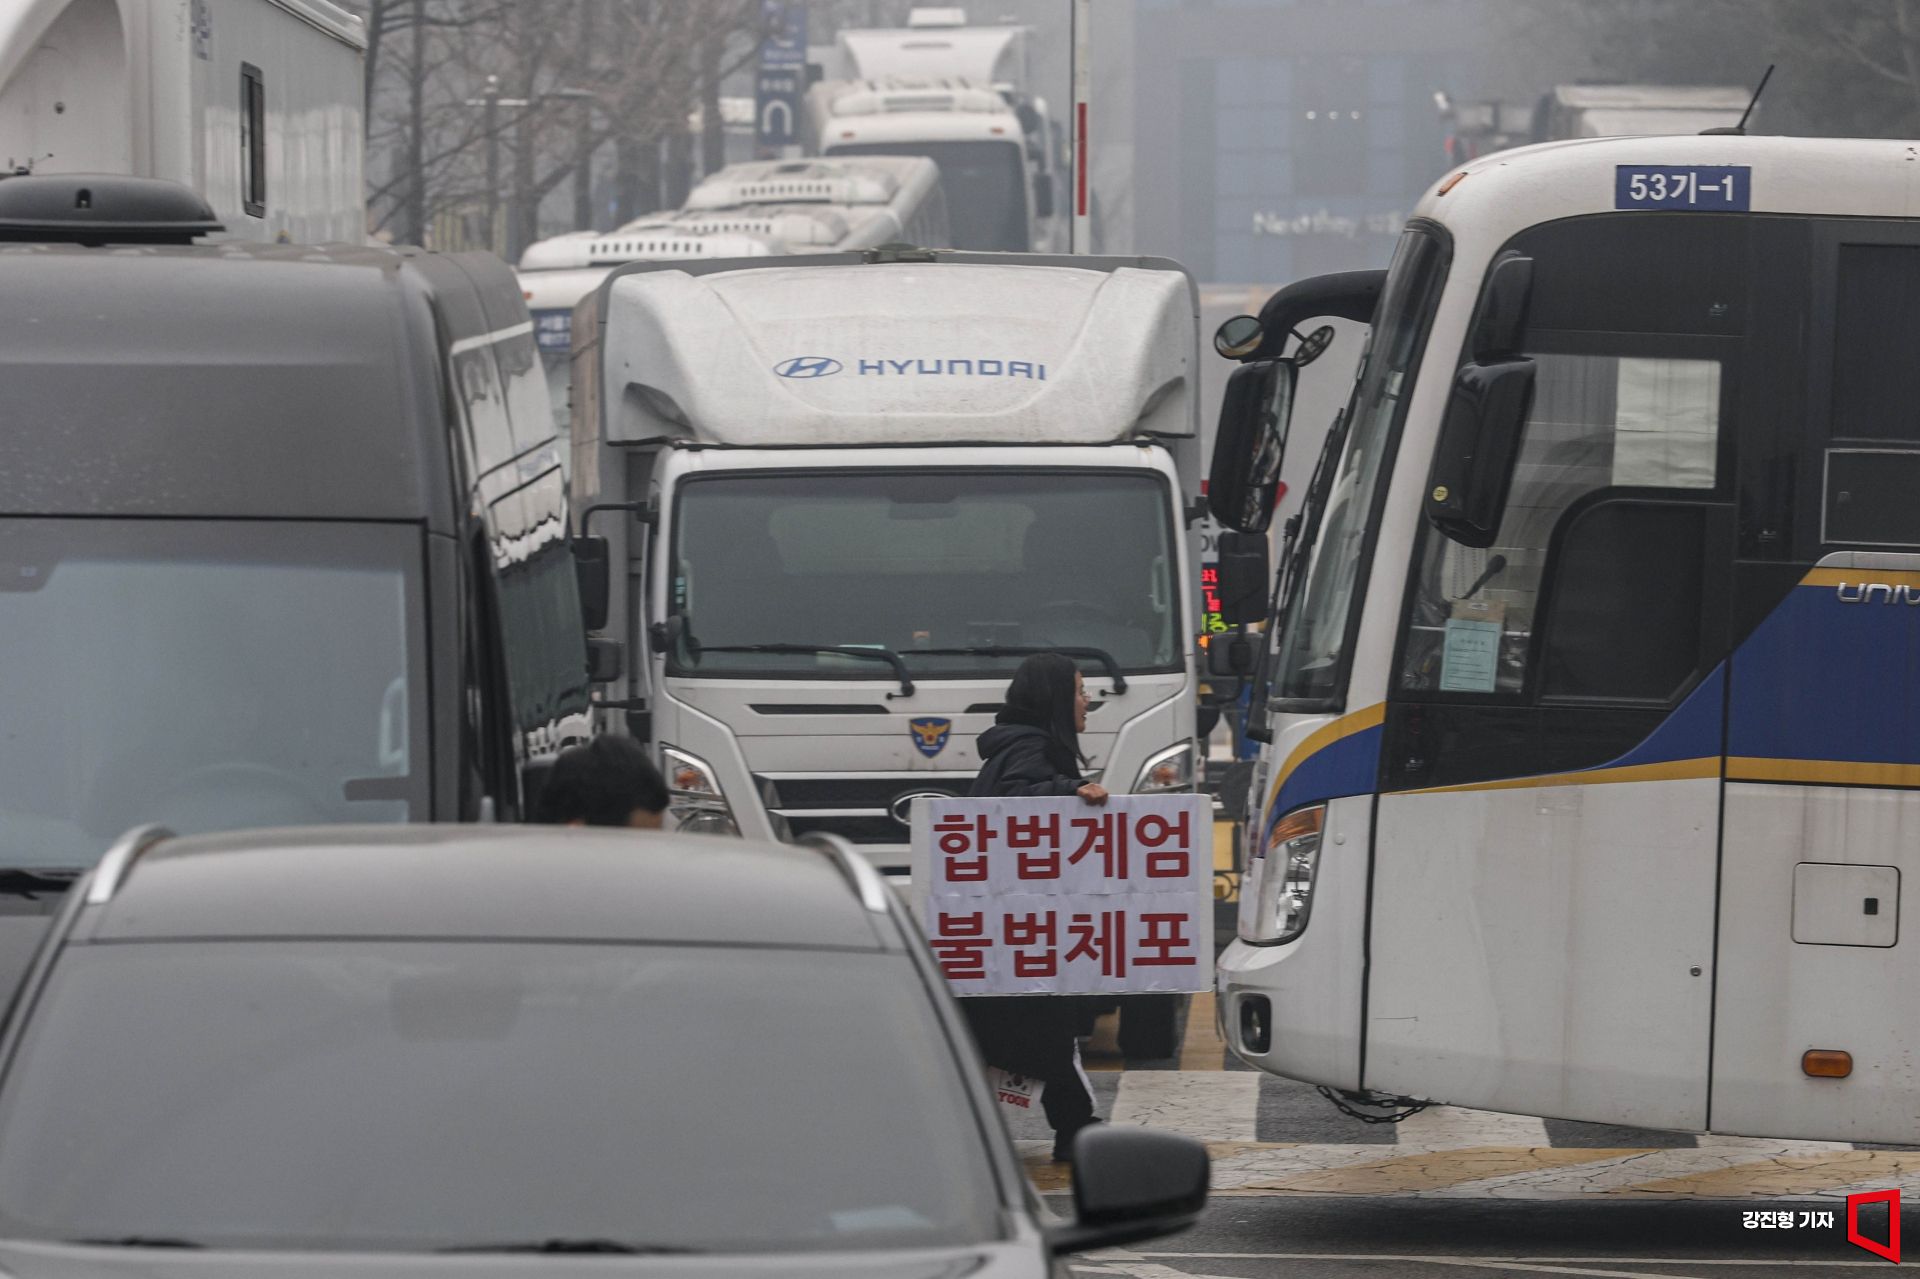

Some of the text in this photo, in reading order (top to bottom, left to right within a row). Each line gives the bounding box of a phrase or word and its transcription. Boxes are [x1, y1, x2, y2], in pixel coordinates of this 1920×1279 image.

[1629, 172, 1734, 204] 53기-1
[858, 358, 1047, 381] HYUNDAI
[933, 810, 1190, 882] 합법계엄
[929, 910, 1197, 980] 불법체포
